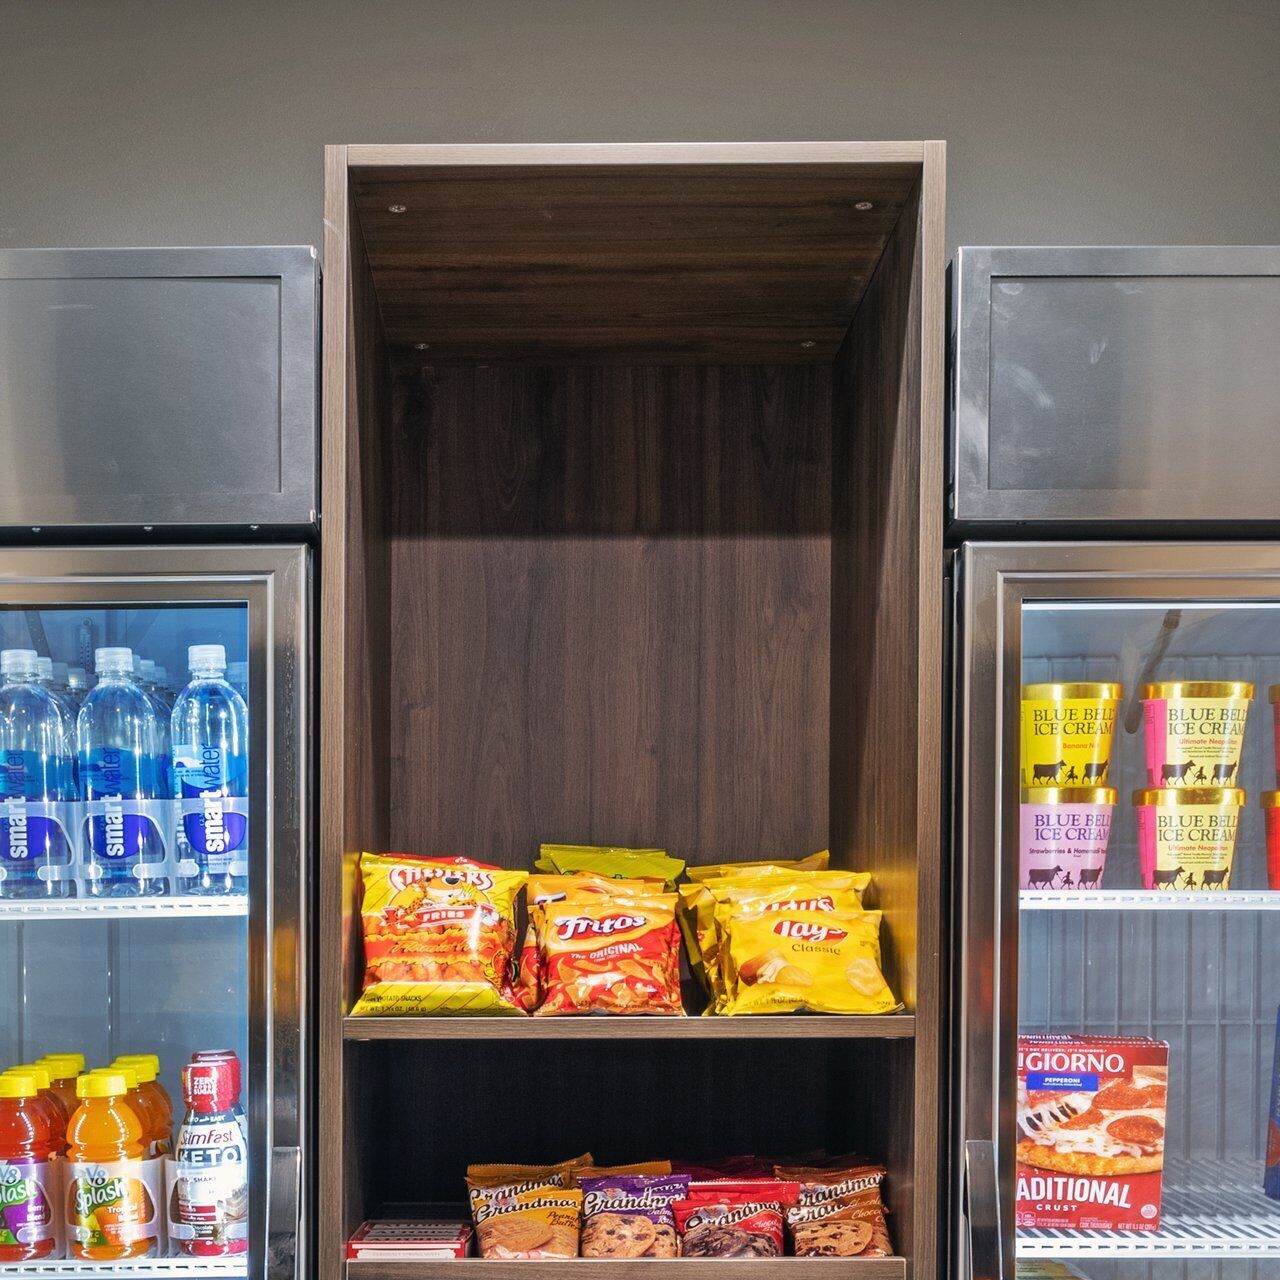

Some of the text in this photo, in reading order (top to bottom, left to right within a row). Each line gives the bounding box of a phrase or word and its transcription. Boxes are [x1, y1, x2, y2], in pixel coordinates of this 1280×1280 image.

[1033, 708, 1115, 722] BLUE BELL
[1168, 708, 1215, 722] BLUE
[1034, 722, 1112, 736] ICE CREAM
[1168, 722, 1195, 736] ICE
[1179, 738, 1207, 746] Ultimate
[5, 795, 28, 859] smart
[101, 792, 125, 857] smart
[199, 789, 226, 853] smart
[1035, 814, 1081, 827] BLUE
[1158, 815, 1205, 828] BLUE
[1035, 828, 1062, 841] ICE
[1158, 829, 1185, 842] ICE
[423, 910, 465, 921] FRIES
[554, 915, 646, 940] Fritos
[589, 943, 643, 959] ORIGINAL
[792, 943, 841, 955] Classic
[180, 1147, 241, 1167] KETO
[85, 1166, 107, 1186] V8
[76, 1177, 128, 1216] Splash
[1036, 1203, 1077, 1211] CRUST
